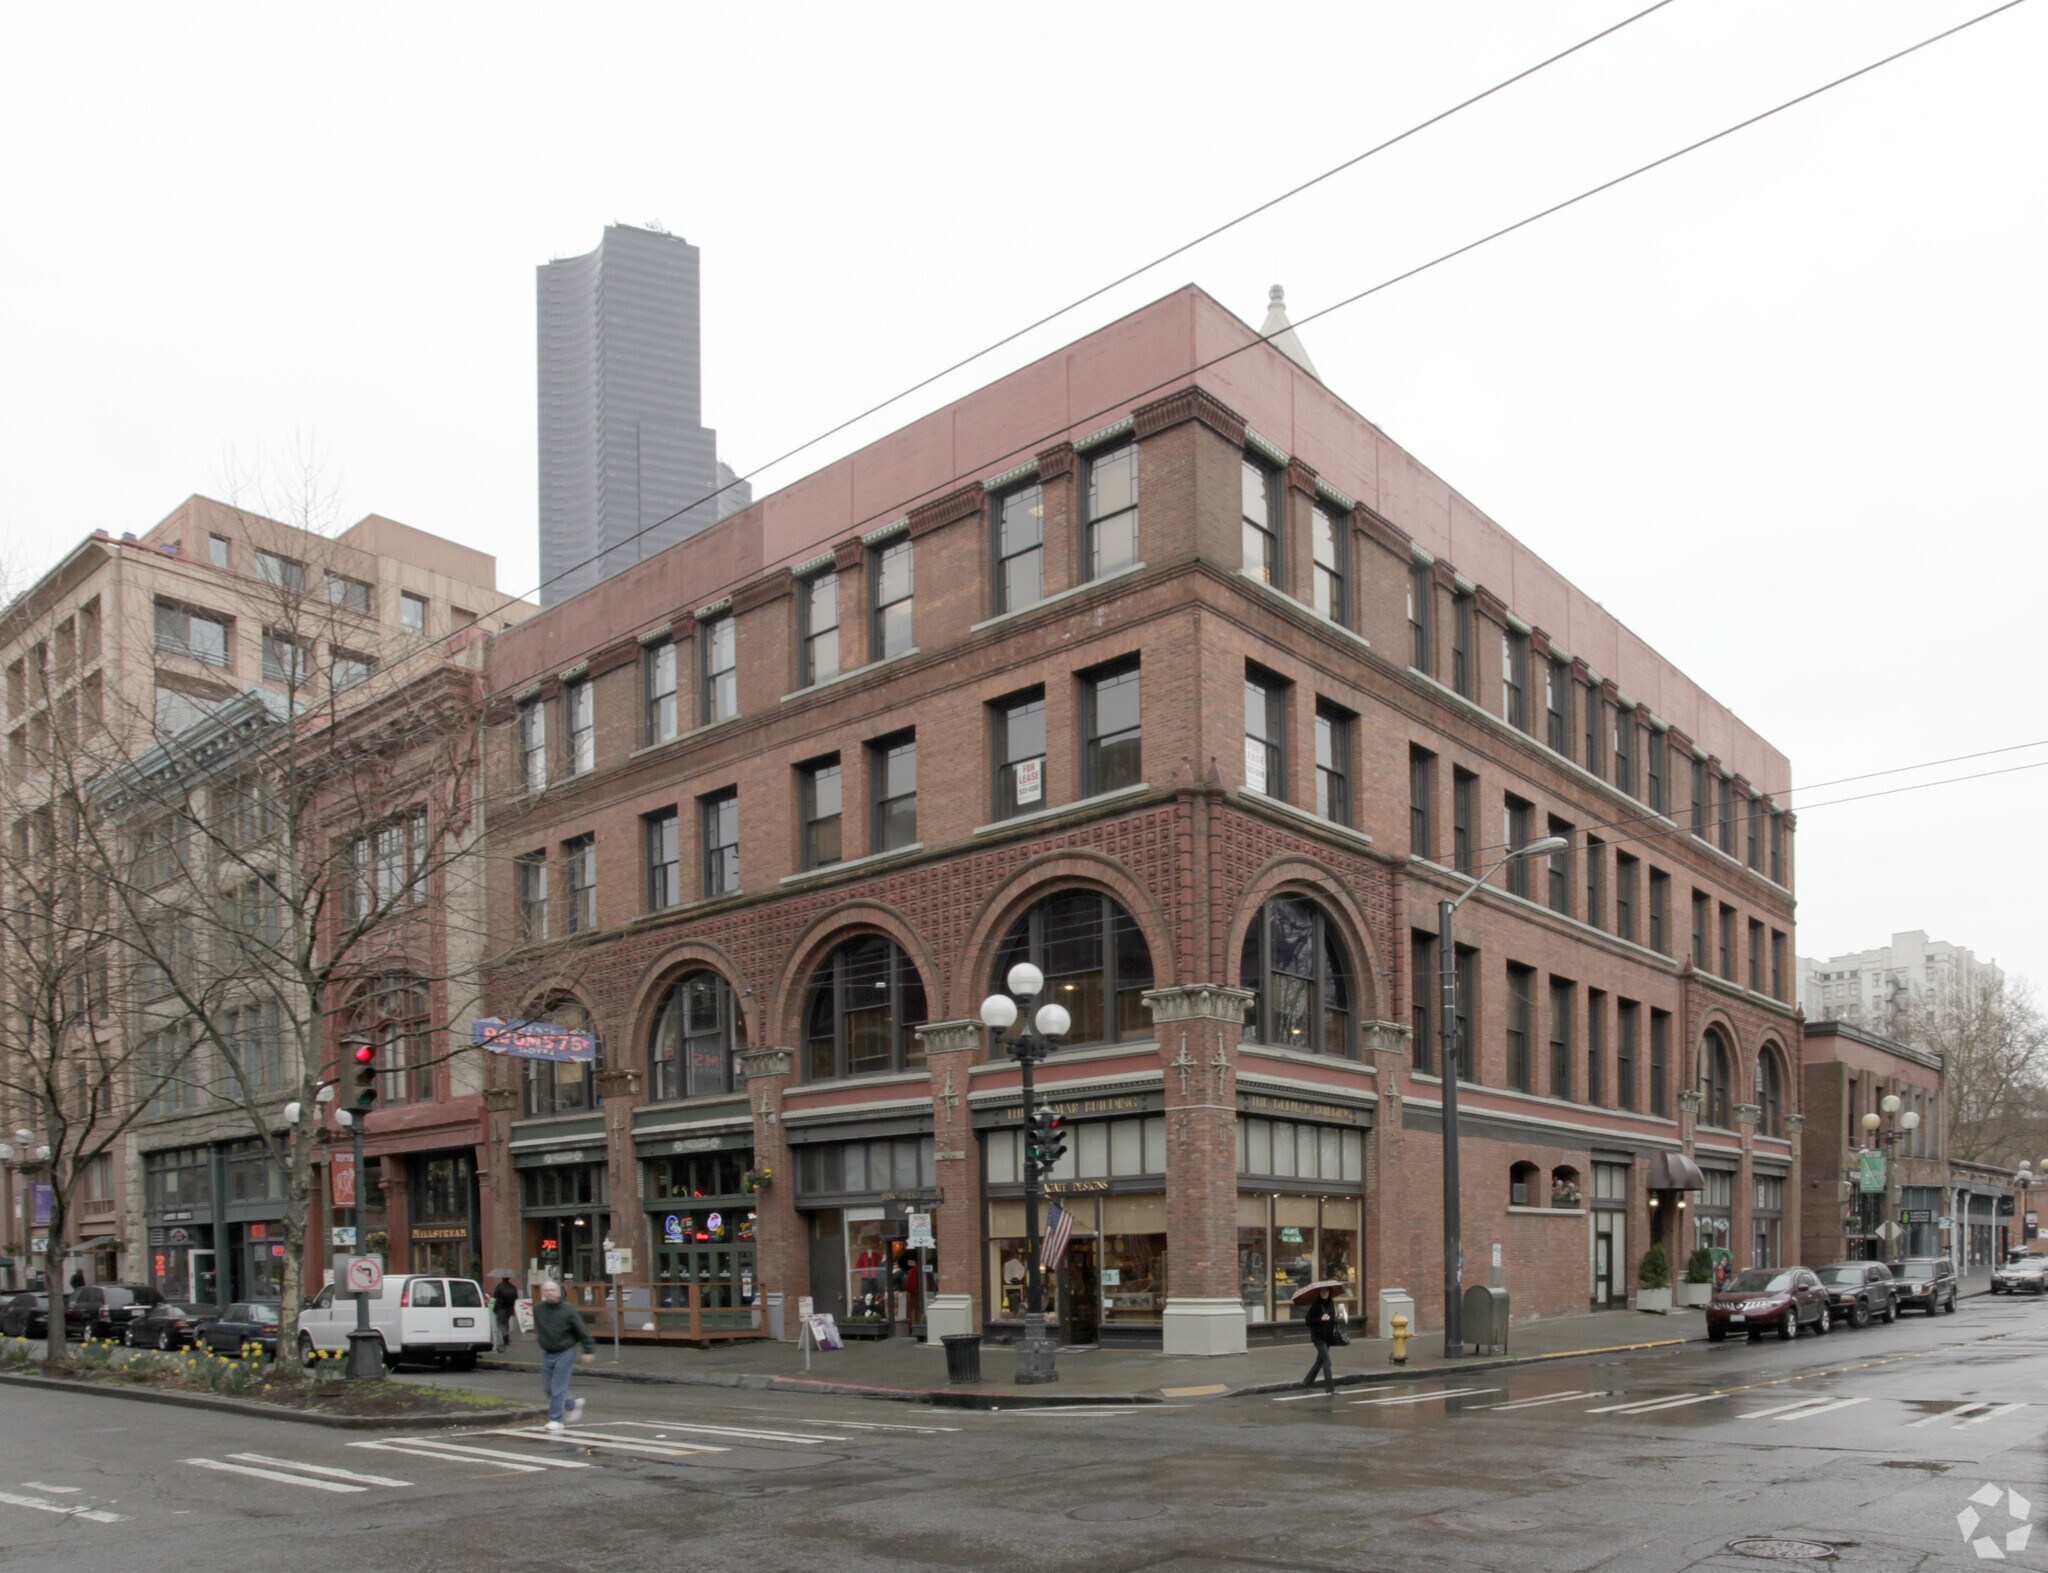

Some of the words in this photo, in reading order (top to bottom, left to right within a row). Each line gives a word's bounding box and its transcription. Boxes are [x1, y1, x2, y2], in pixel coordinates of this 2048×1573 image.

[1022, 762, 1036, 773] FOR
[1019, 771, 1039, 784] LEASE
[484, 1027, 555, 1049] ROOMS
[1084, 1097, 1137, 1112] BUILDING
[1313, 1105, 1353, 1120] BUILDING
[1042, 1183, 1068, 1193] AGATE
[1073, 1180, 1109, 1191] DESIGNS
[412, 1229, 467, 1239] MILLSTREAM
